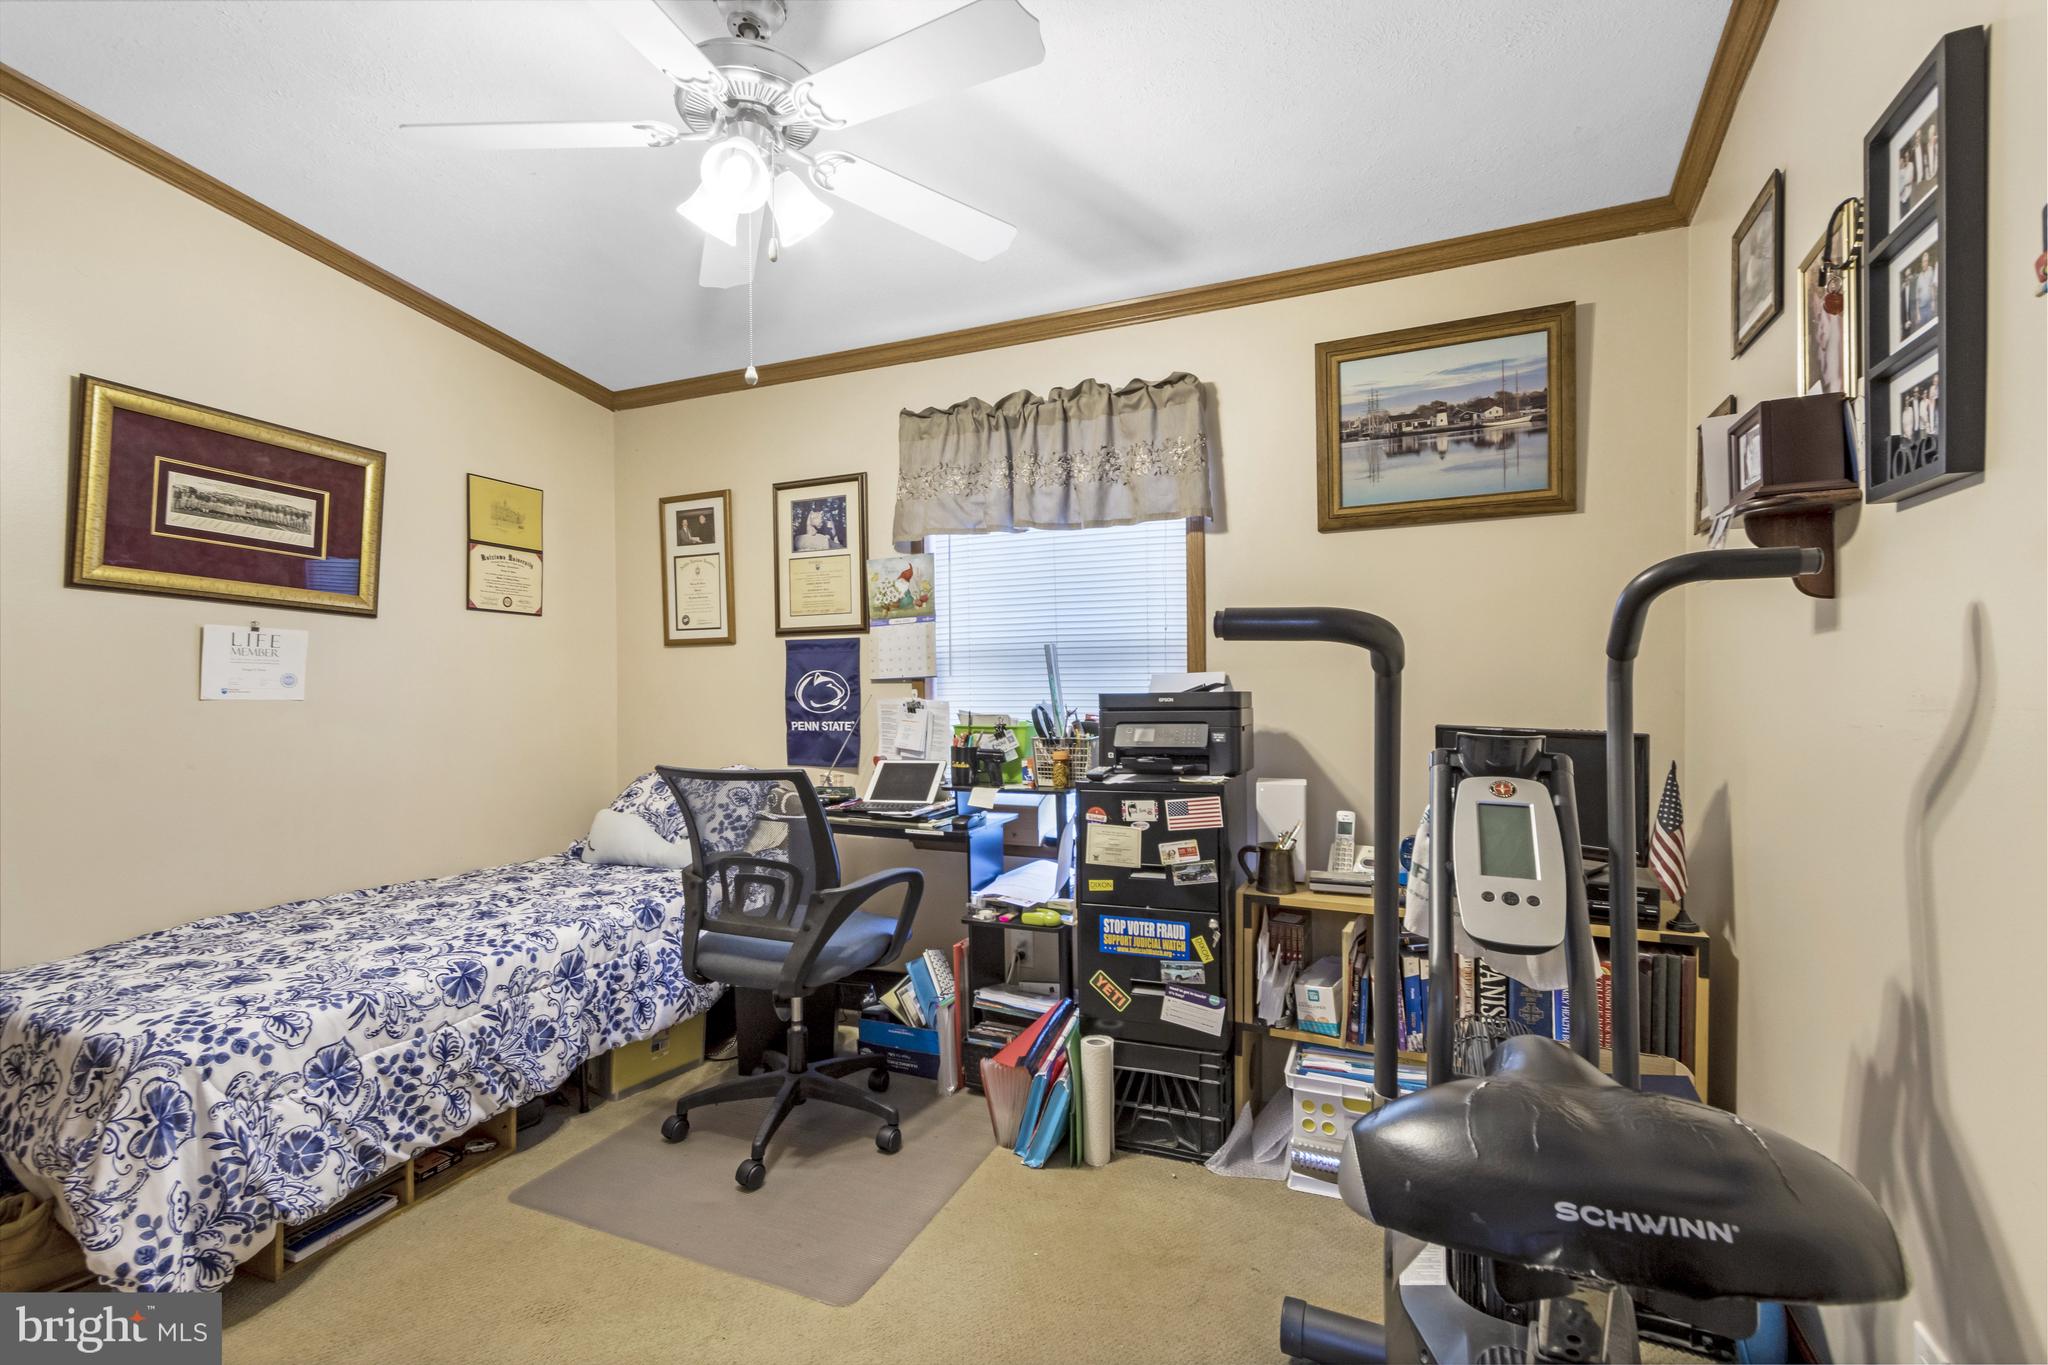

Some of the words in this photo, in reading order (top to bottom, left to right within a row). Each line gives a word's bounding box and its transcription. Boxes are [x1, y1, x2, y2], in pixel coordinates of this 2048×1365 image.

[231, 632, 281, 648] LIFE
[231, 647, 280, 657] MEMBER
[791, 721, 820, 731] PENN
[821, 721, 853, 731] STATE
[1103, 918, 1126, 934] STOP
[1127, 920, 1155, 937] VOTER
[1156, 922, 1186, 940] FRAUD
[1103, 933, 1133, 946] SUPPORT
[1133, 936, 1161, 949] JUDICIAL
[1162, 939, 1186, 952] WATCH
[1094, 974, 1126, 1007] YETI
[1562, 1006, 1570, 1032] HEALTH
[1554, 1201, 1736, 1243] SCHWINN
